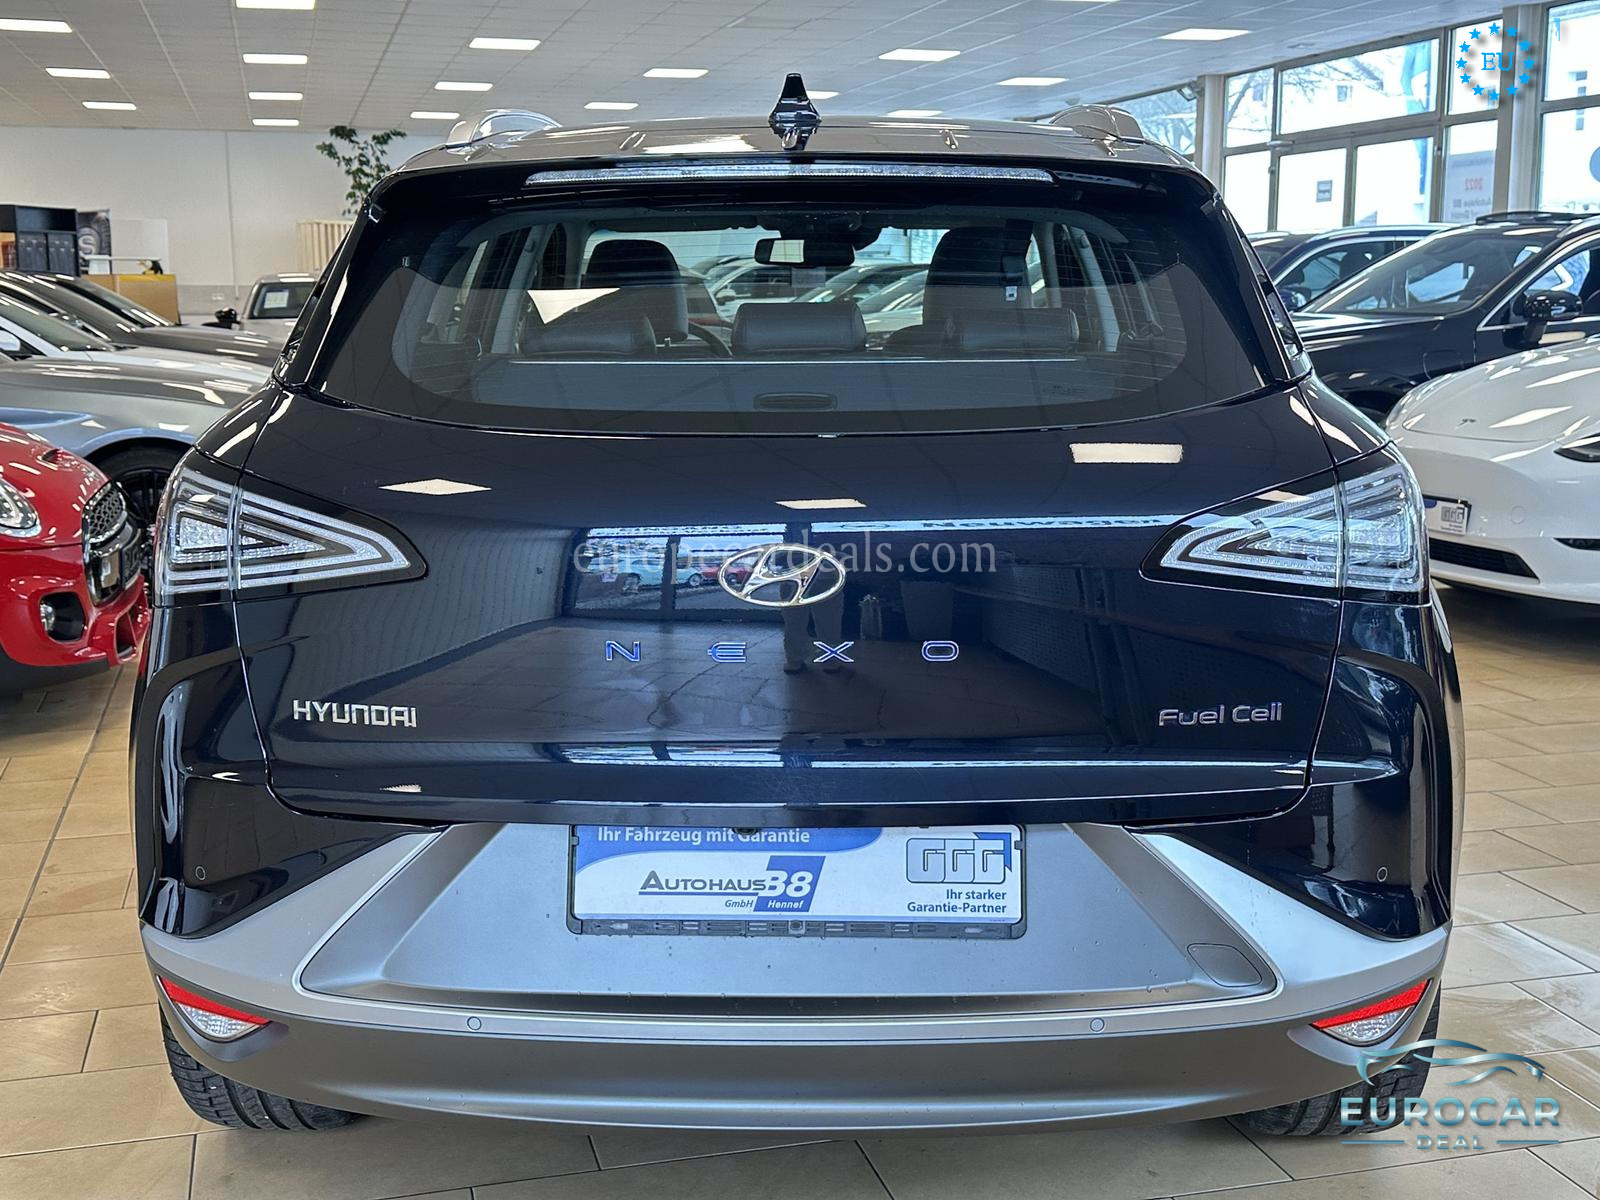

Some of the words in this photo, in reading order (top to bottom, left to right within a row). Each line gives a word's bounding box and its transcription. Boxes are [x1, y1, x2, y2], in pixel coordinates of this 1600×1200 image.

[605, 640, 960, 664] NEXO
[292, 700, 417, 728] HYUNDAI
[1158, 704, 1225, 727] Fuel
[1232, 702, 1282, 723] Cell
[598, 827, 622, 842] Ihr
[625, 827, 701, 846] Fahrzeug
[706, 828, 734, 842] mit
[946, 889, 962, 900] Ihr
[965, 889, 1007, 900] starker
[725, 900, 753, 908] GmbH
[767, 900, 804, 909] Hennef
[907, 901, 1007, 913] Garantie-Partner
